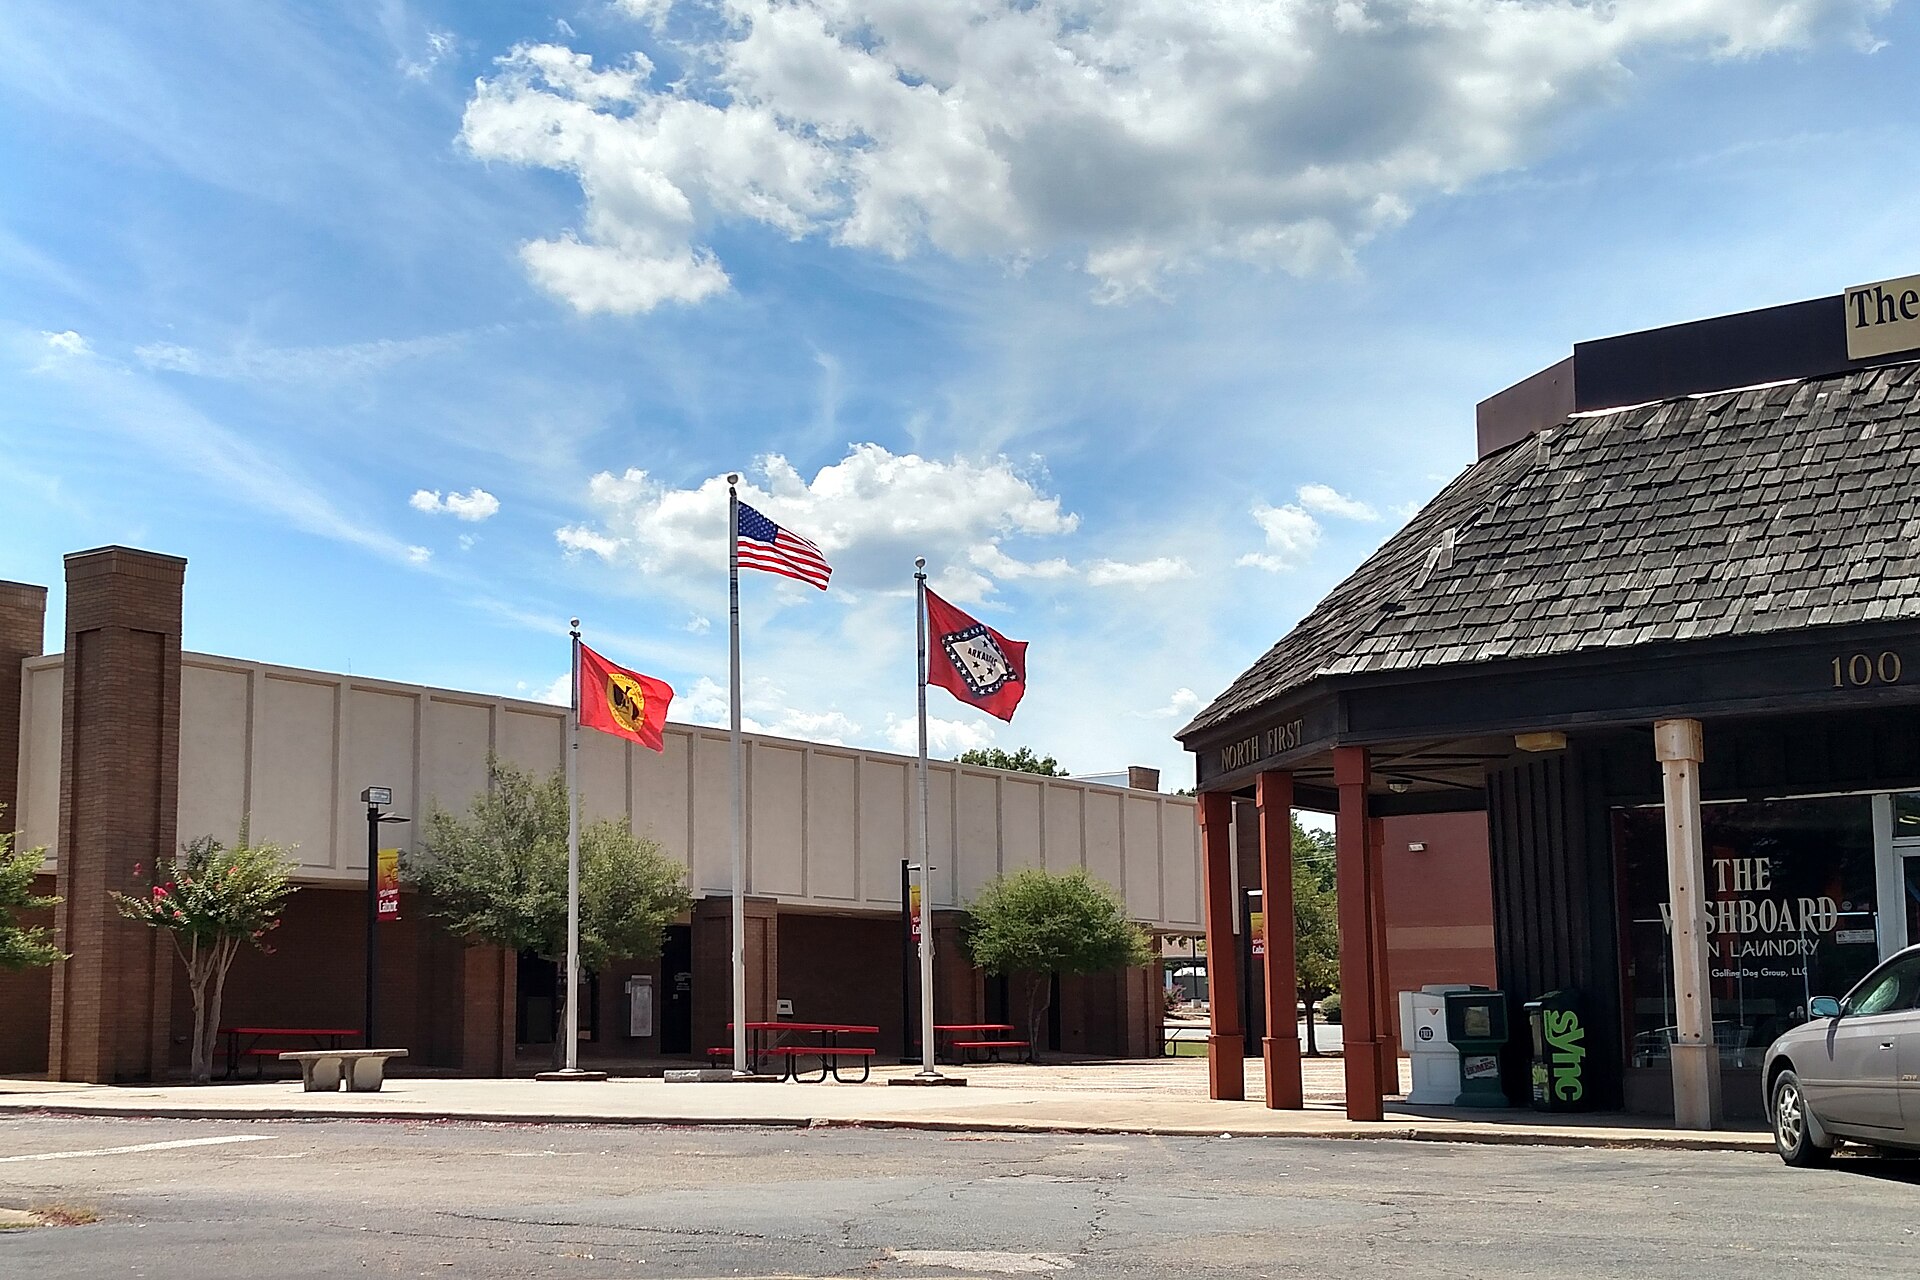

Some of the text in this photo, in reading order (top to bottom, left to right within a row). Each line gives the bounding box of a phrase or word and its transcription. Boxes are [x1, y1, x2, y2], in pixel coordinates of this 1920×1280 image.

[1848, 286, 1920, 329] The
[967, 647, 998, 667] ARKAS
[1831, 651, 1902, 688] 100
[1221, 719, 1304, 772] NORTH FIRST
[1712, 857, 1772, 892] THE
[1658, 896, 1838, 936] WSHBOARD
[1730, 939, 1820, 958] LAUNDRY
[1742, 968, 1759, 979] Dog
[1465, 1060, 1497, 1076] HOMES
